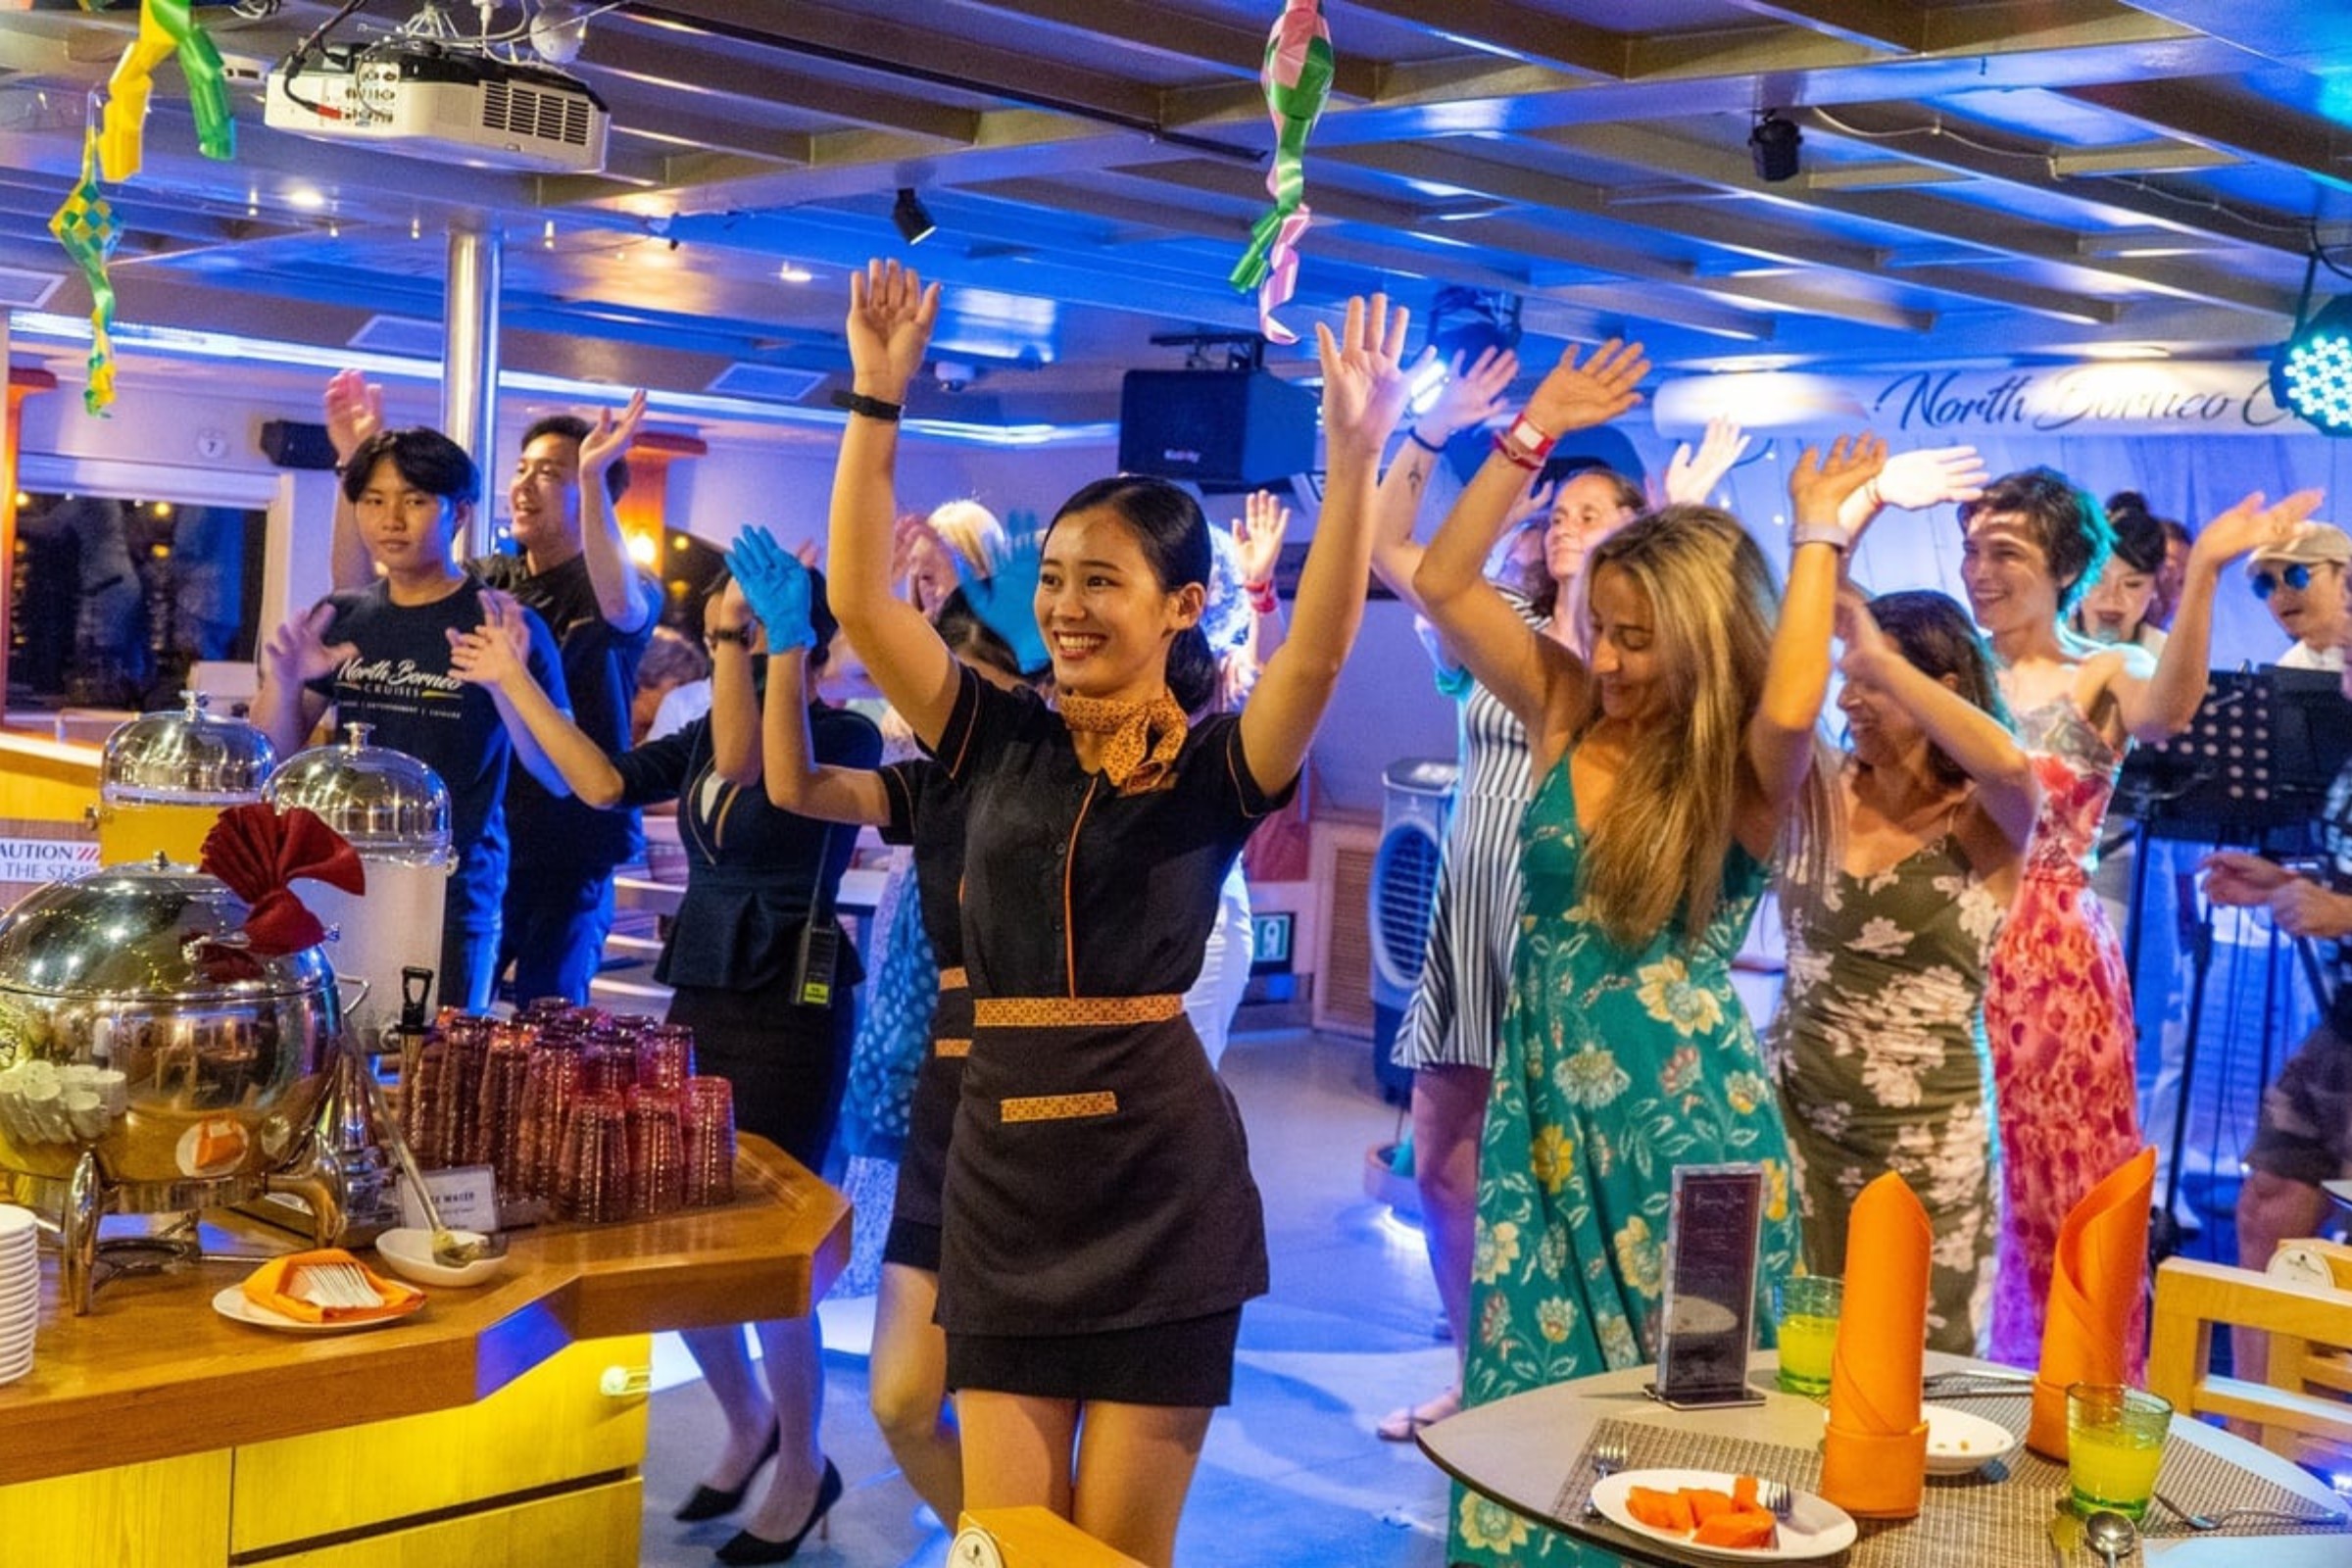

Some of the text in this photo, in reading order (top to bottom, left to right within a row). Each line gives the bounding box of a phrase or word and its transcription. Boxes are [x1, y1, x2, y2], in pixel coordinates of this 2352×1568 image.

[1873, 368, 2033, 430] North
[336, 657, 463, 691] North Borneo
[0, 843, 74, 860] AUTION
[6, 861, 41, 880] THE
